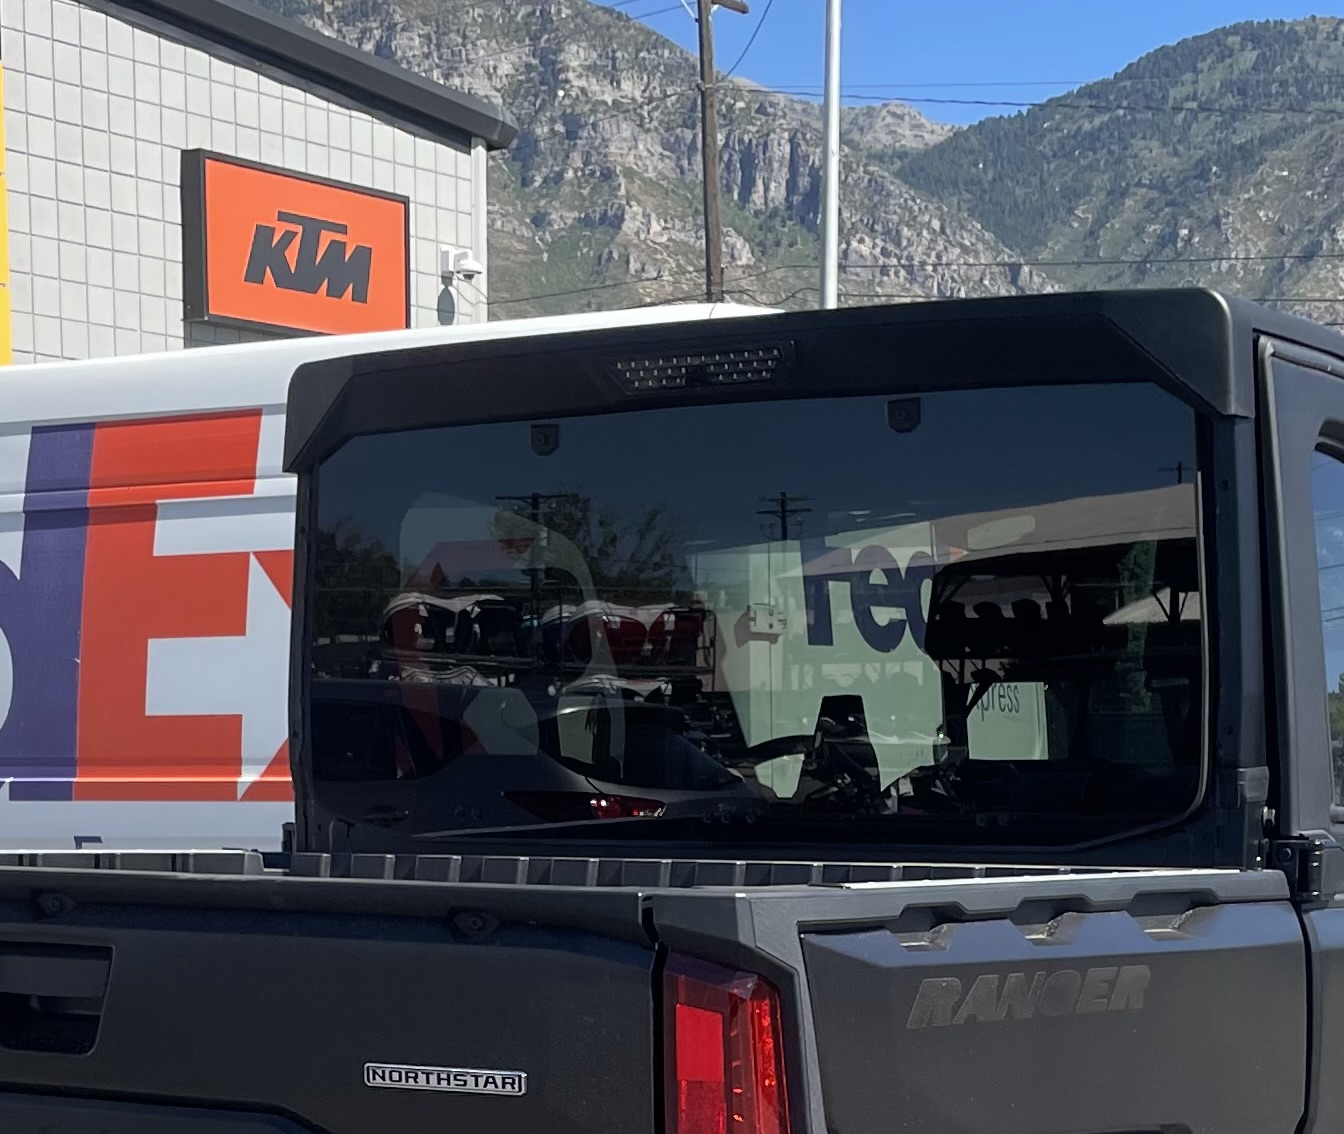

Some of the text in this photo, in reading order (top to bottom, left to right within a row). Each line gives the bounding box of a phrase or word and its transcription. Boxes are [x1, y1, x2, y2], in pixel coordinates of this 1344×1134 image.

[244, 210, 372, 304] KTM
[975, 683, 1020, 722] press
[906, 964, 1152, 1029] RANGER
[371, 1067, 517, 1091] NORTHSTAR
